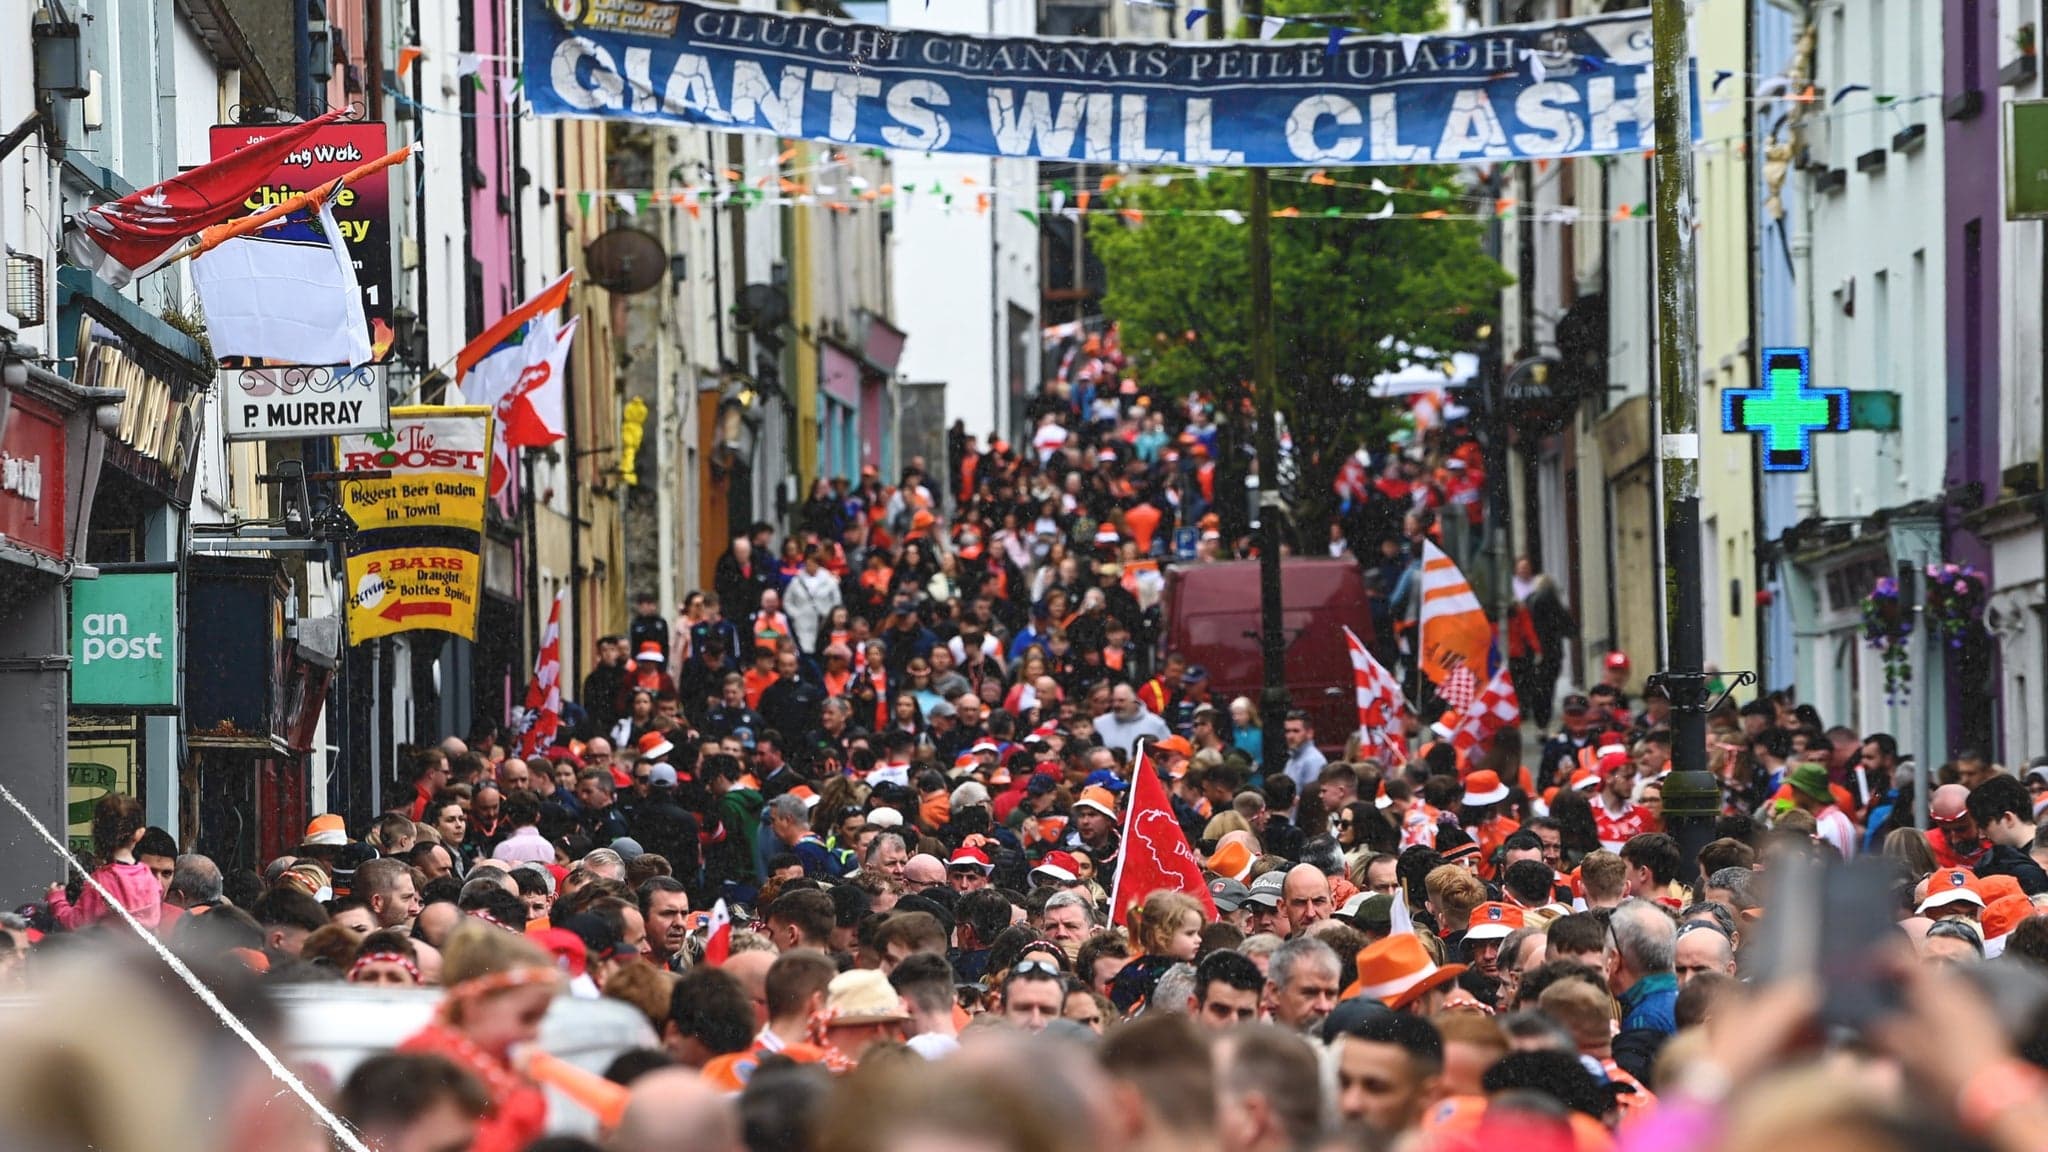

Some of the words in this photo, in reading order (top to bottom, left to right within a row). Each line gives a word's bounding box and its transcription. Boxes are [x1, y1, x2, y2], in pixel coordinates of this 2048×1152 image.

[595, 11, 618, 25] THE
[623, 14, 672, 32] GIANTS
[693, 11, 900, 61] CLUICHI
[921, 37, 1169, 77] CEANNAIS
[1186, 50, 1326, 81] PEILE
[1346, 37, 1515, 79] ULADH
[550, 35, 952, 152] GIANTS
[987, 87, 1245, 162] WILL
[1285, 66, 1656, 163] CLASH
[314, 143, 363, 162] Wok
[243, 184, 355, 211] Chine
[243, 405, 259, 428] P.
[267, 401, 363, 427] MURRAY
[396, 424, 435, 451] The
[344, 449, 484, 472] ROOST
[351, 486, 397, 507] Biggest
[402, 484, 429, 498] Beer
[435, 482, 476, 497] Garden
[386, 507, 398, 520] In
[405, 503, 441, 518] Town!
[367, 561, 382, 575] 2
[389, 556, 464, 572] BARS
[417, 569, 460, 586] Draught
[350, 579, 397, 610] Serving
[400, 584, 440, 597] Bottles
[82, 613, 128, 636] an
[82, 632, 163, 665] post
